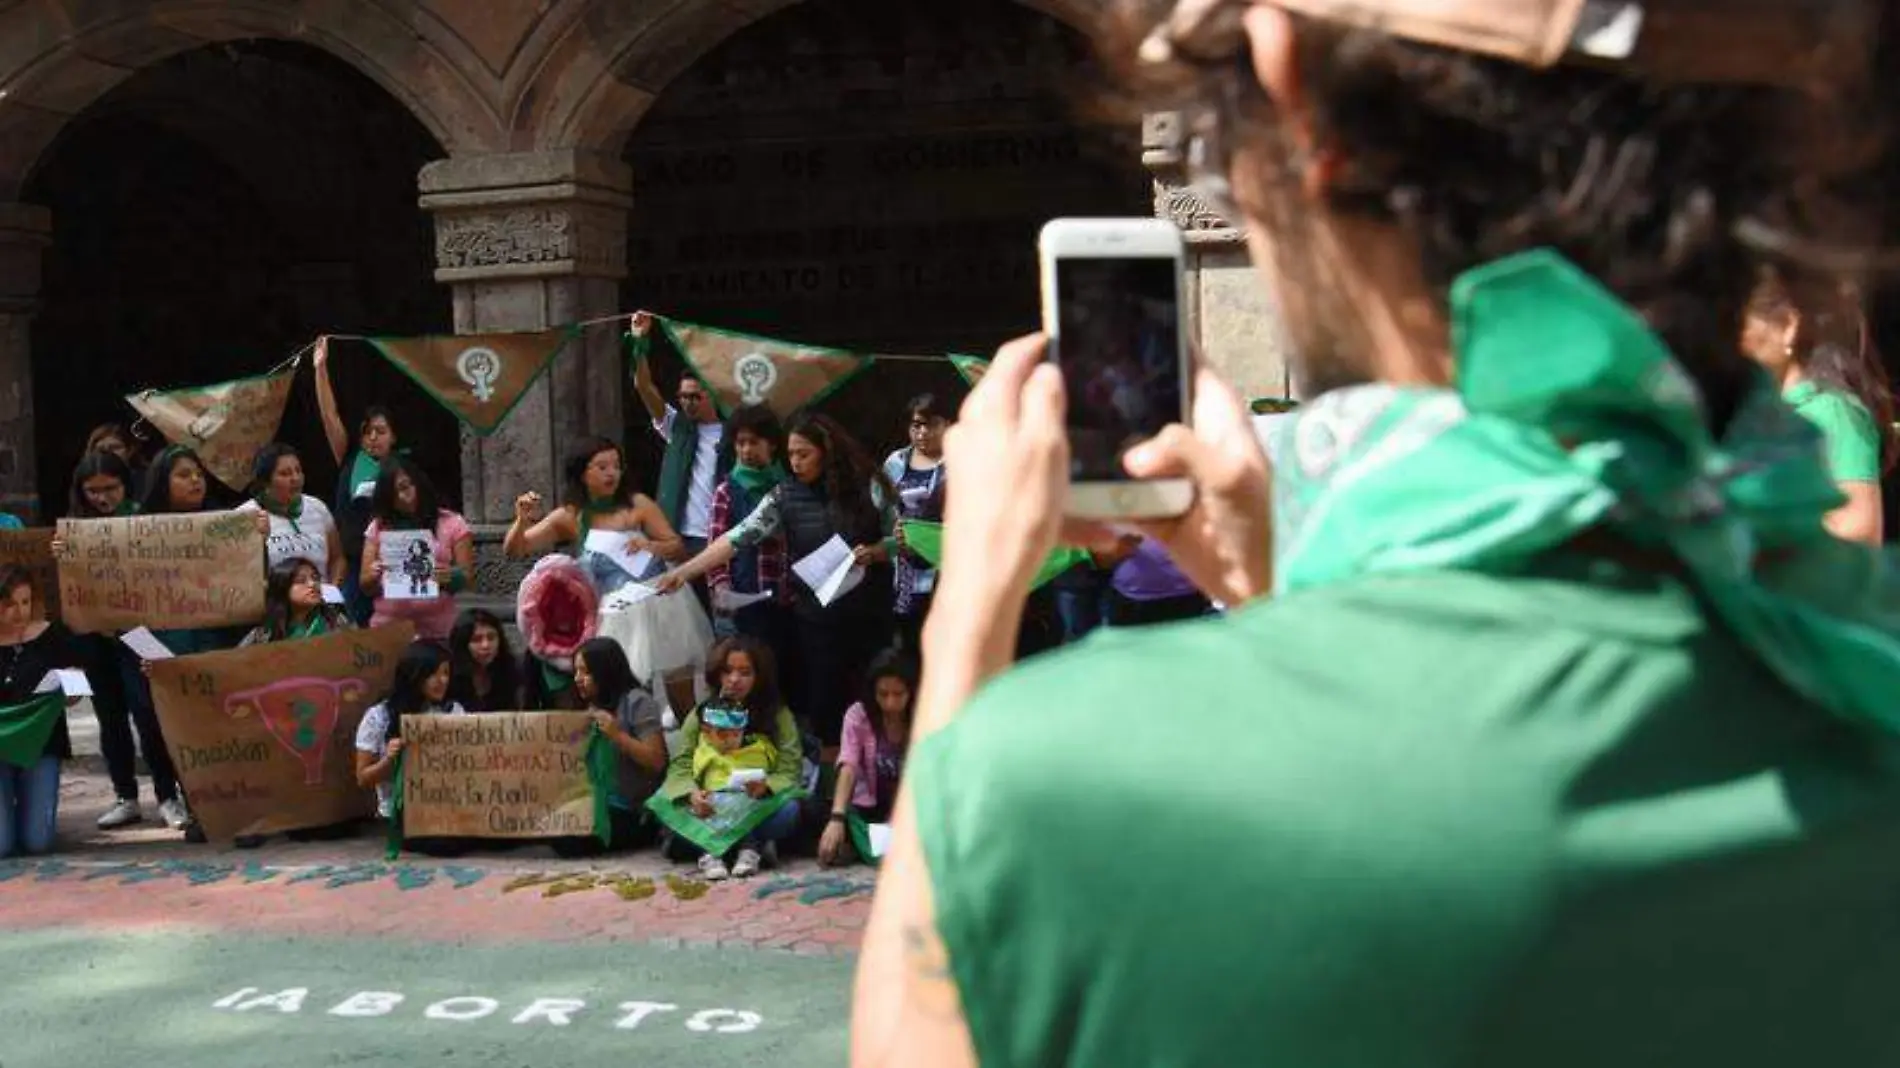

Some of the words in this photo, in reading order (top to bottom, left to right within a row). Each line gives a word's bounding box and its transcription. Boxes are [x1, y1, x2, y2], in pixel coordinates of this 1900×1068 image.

[634, 153, 738, 187] ACIO
[781, 146, 827, 179] DE
[873, 136, 1079, 175] GOBIERNO
[837, 264, 875, 290] DE
[510, 718, 536, 743] No
